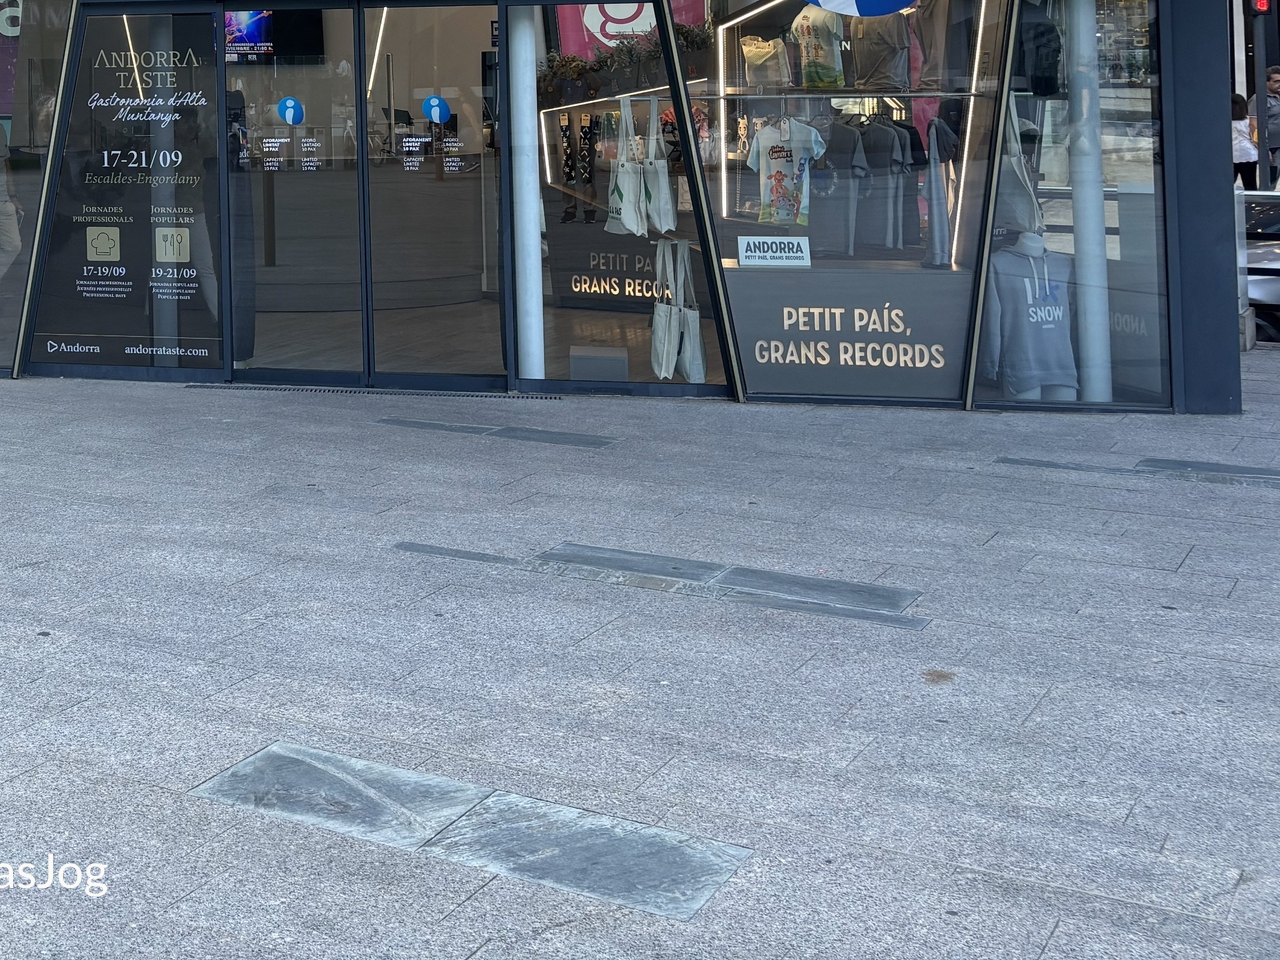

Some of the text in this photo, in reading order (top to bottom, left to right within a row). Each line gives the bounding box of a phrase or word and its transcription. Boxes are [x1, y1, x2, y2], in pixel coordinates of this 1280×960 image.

[94, 48, 199, 68] ANDORRA
[116, 72, 177, 89] TASTE
[87, 91, 208, 109] Gastronomia d'Alta
[113, 106, 182, 128] Muntanya
[101, 149, 183, 169] 17-21/09
[84, 172, 200, 188] Escaldes-Engordany
[72, 215, 134, 223] PROFESSIONALS
[150, 216, 195, 224] POPULARS
[745, 240, 804, 254] ANDORRA
[590, 252, 657, 273] PETIT PA
[82, 266, 126, 277] 17-19/09
[151, 268, 197, 279] 19-21/09
[571, 275, 673, 299] GRANS RECOR
[783, 302, 912, 336] PETIT PAÍS,
[1028, 306, 1063, 322] SNOW
[59, 342, 209, 356] Andorra andorrataste.com
[755, 340, 946, 369] GRANS RECORDS
